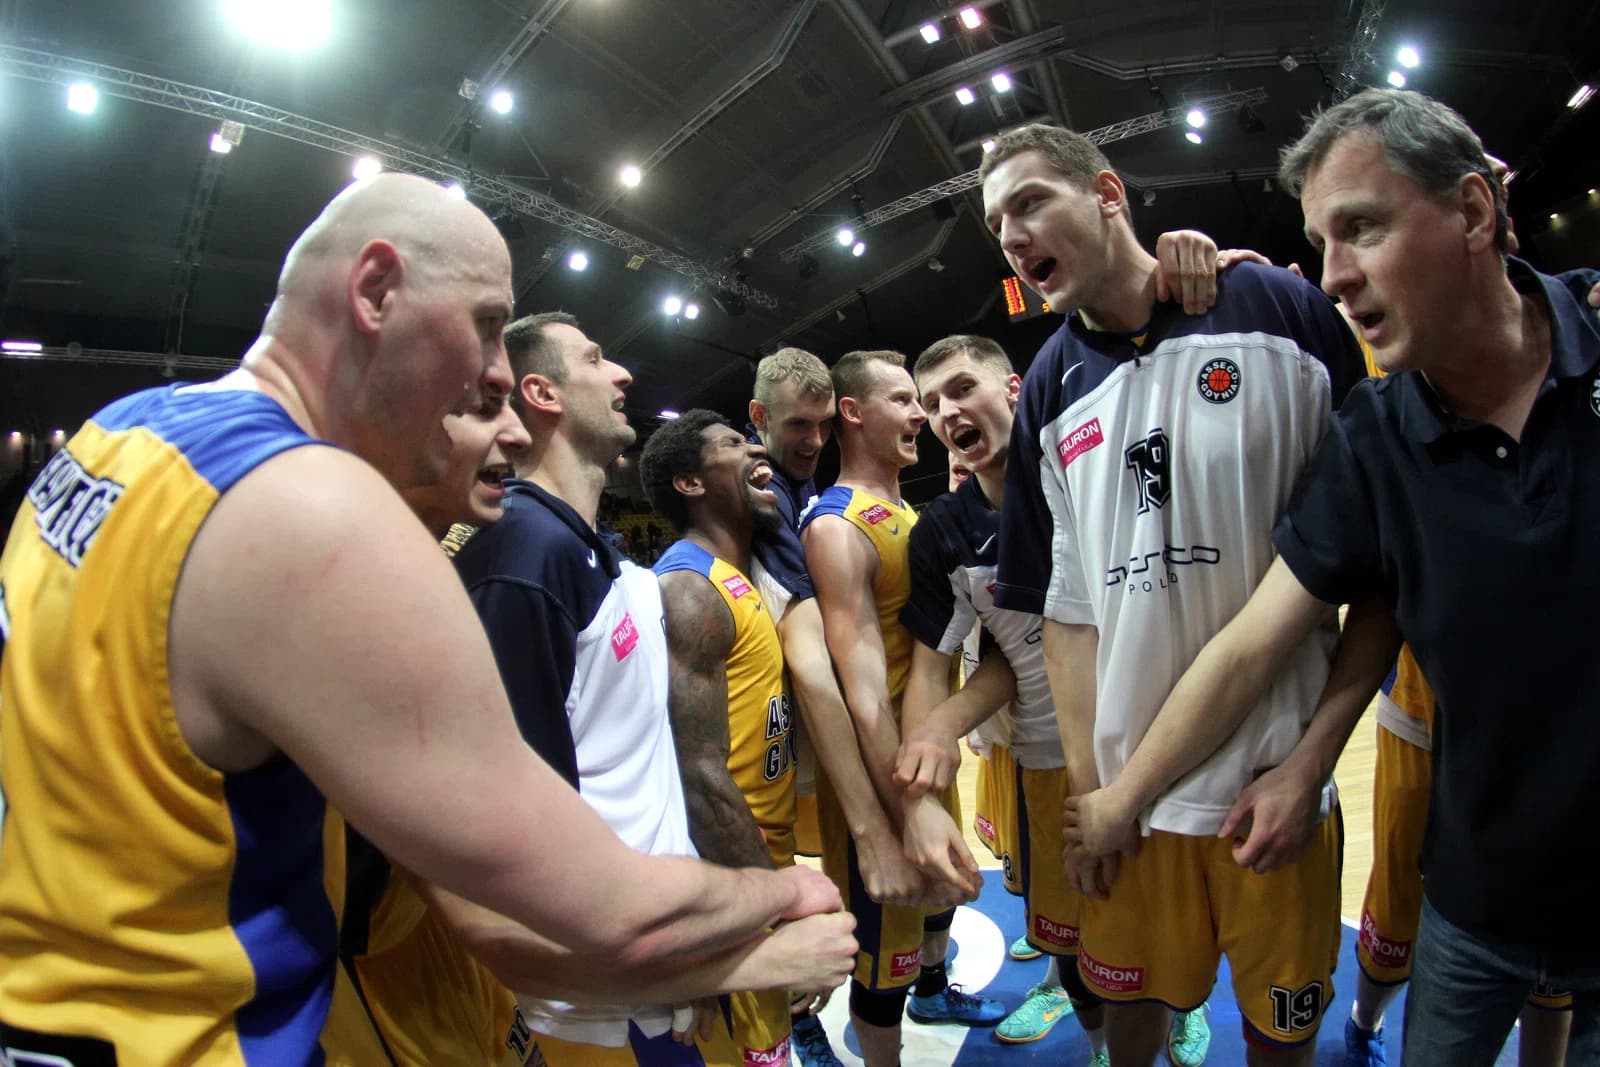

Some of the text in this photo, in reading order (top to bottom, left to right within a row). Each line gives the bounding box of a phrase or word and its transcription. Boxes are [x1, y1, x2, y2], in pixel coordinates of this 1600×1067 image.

[1201, 361, 1238, 380] ASSECO
[1200, 383, 1238, 400] GDYNIA
[1060, 421, 1100, 457] TAURON
[1125, 428, 1171, 516] 19
[1039, 918, 1080, 939] TAUR
[895, 946, 924, 967] TAU
[1080, 947, 1140, 982] TAURON
[1269, 981, 1323, 1032] 19
